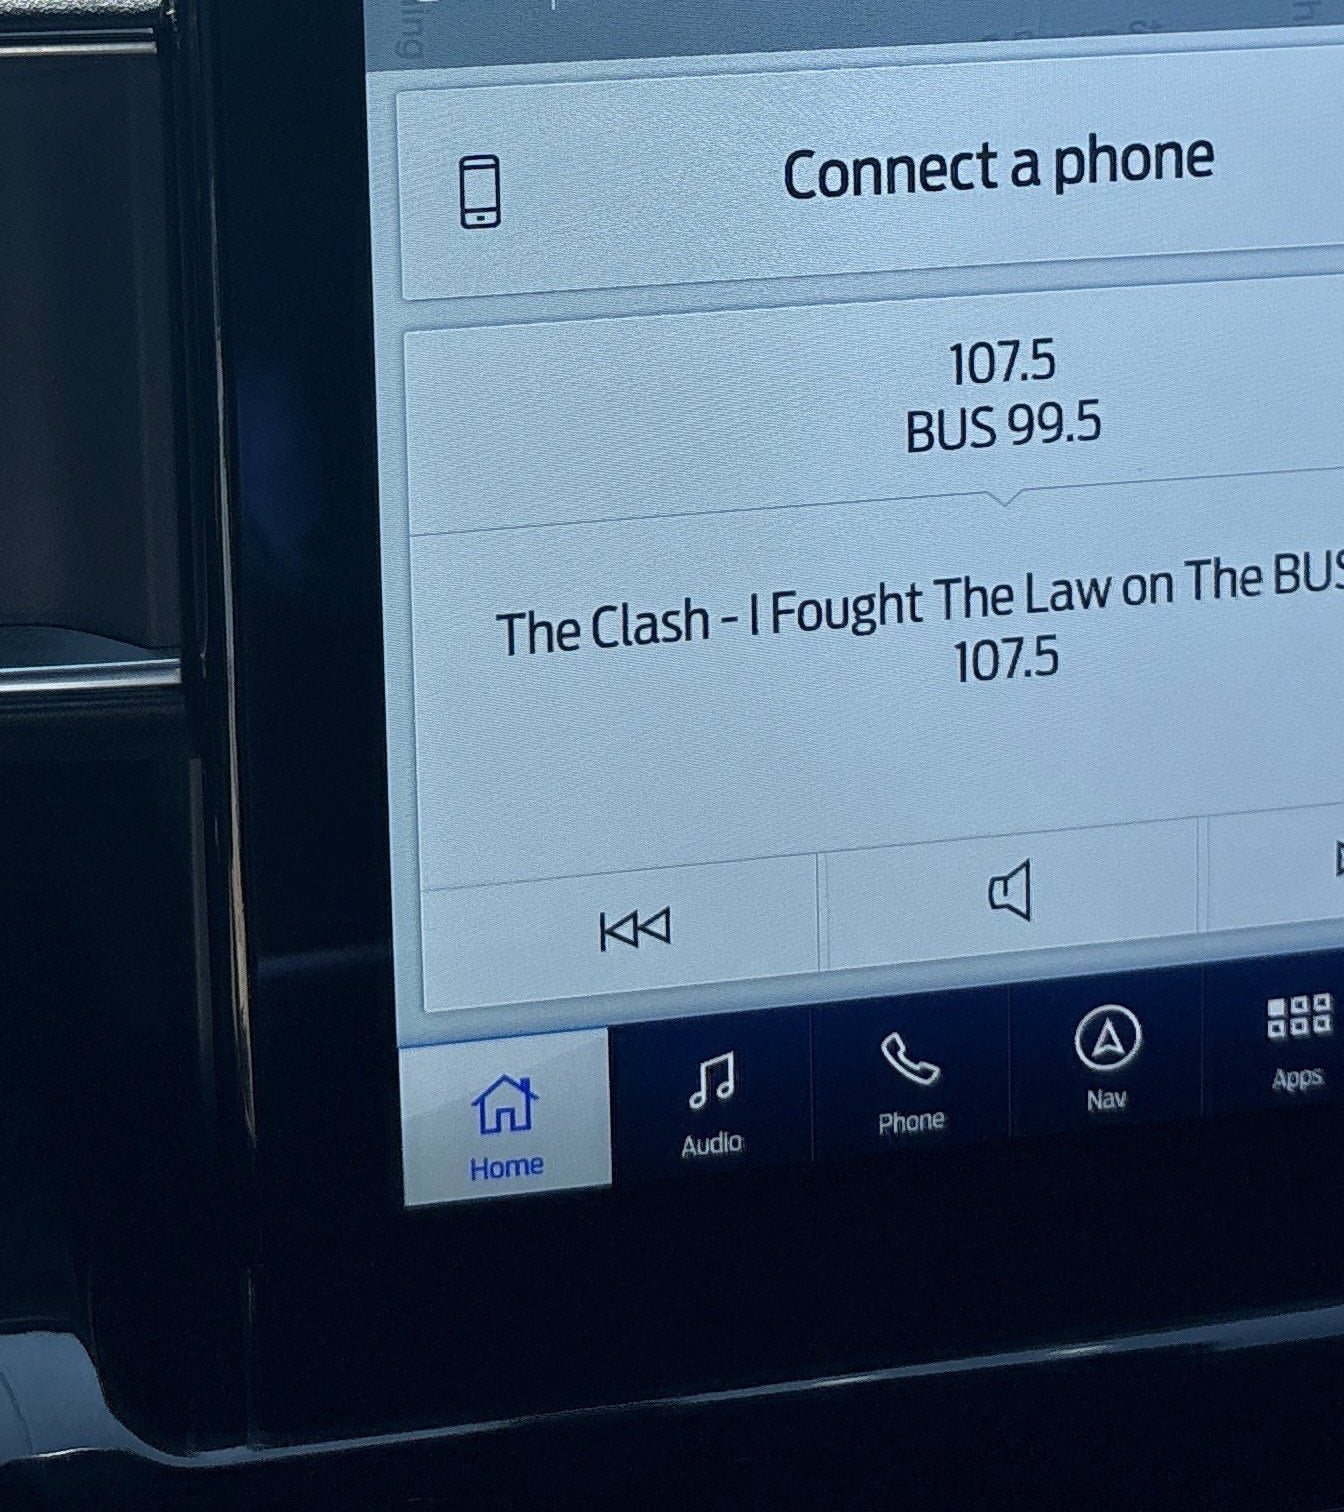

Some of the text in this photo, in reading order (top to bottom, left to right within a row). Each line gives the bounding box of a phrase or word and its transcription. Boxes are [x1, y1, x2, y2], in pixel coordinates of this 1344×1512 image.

[784, 133, 1215, 199] Connect a phone
[949, 337, 1055, 386] 107.5
[907, 399, 1102, 453] BUS 99.5
[496, 612, 581, 657] The
[591, 597, 710, 650] Clash
[750, 592, 760, 636] I
[772, 580, 923, 637] Fought
[932, 575, 1014, 621] The
[1026, 571, 1111, 613] Law
[1122, 565, 1174, 605] on
[1185, 557, 1263, 600] The
[954, 635, 1060, 683] 107.5
[1272, 1064, 1324, 1093] Apps
[1087, 1089, 1127, 1113] Nav
[878, 1108, 945, 1136] Phone
[681, 1131, 743, 1159] Audio
[470, 1155, 544, 1181] Home
